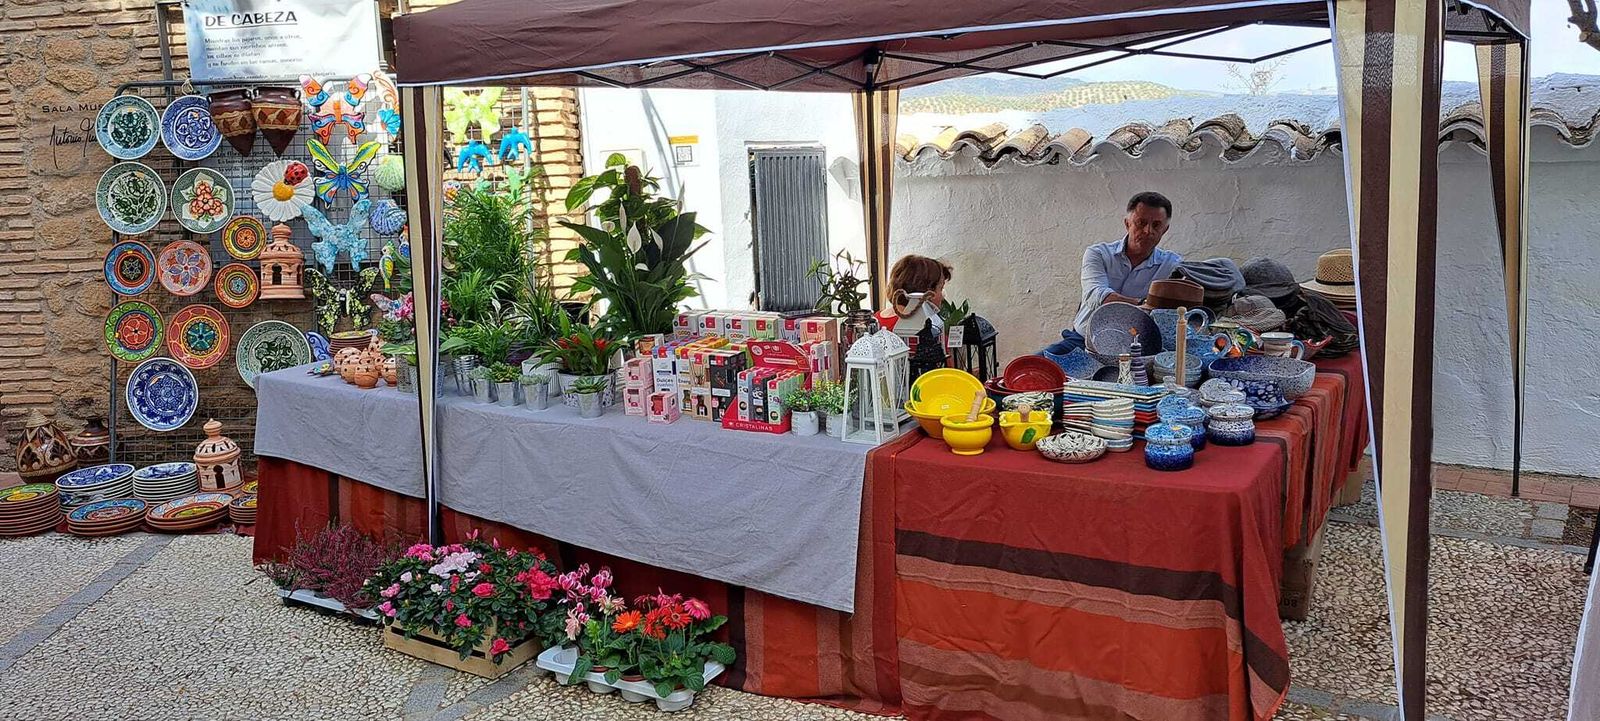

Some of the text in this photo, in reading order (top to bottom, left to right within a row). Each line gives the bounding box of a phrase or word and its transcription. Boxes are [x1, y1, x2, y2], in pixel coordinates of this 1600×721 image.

[205, 11, 298, 27] DE CABEZA
[42, 105, 74, 113] SALA
[735, 422, 773, 431] CRISTALINAS
